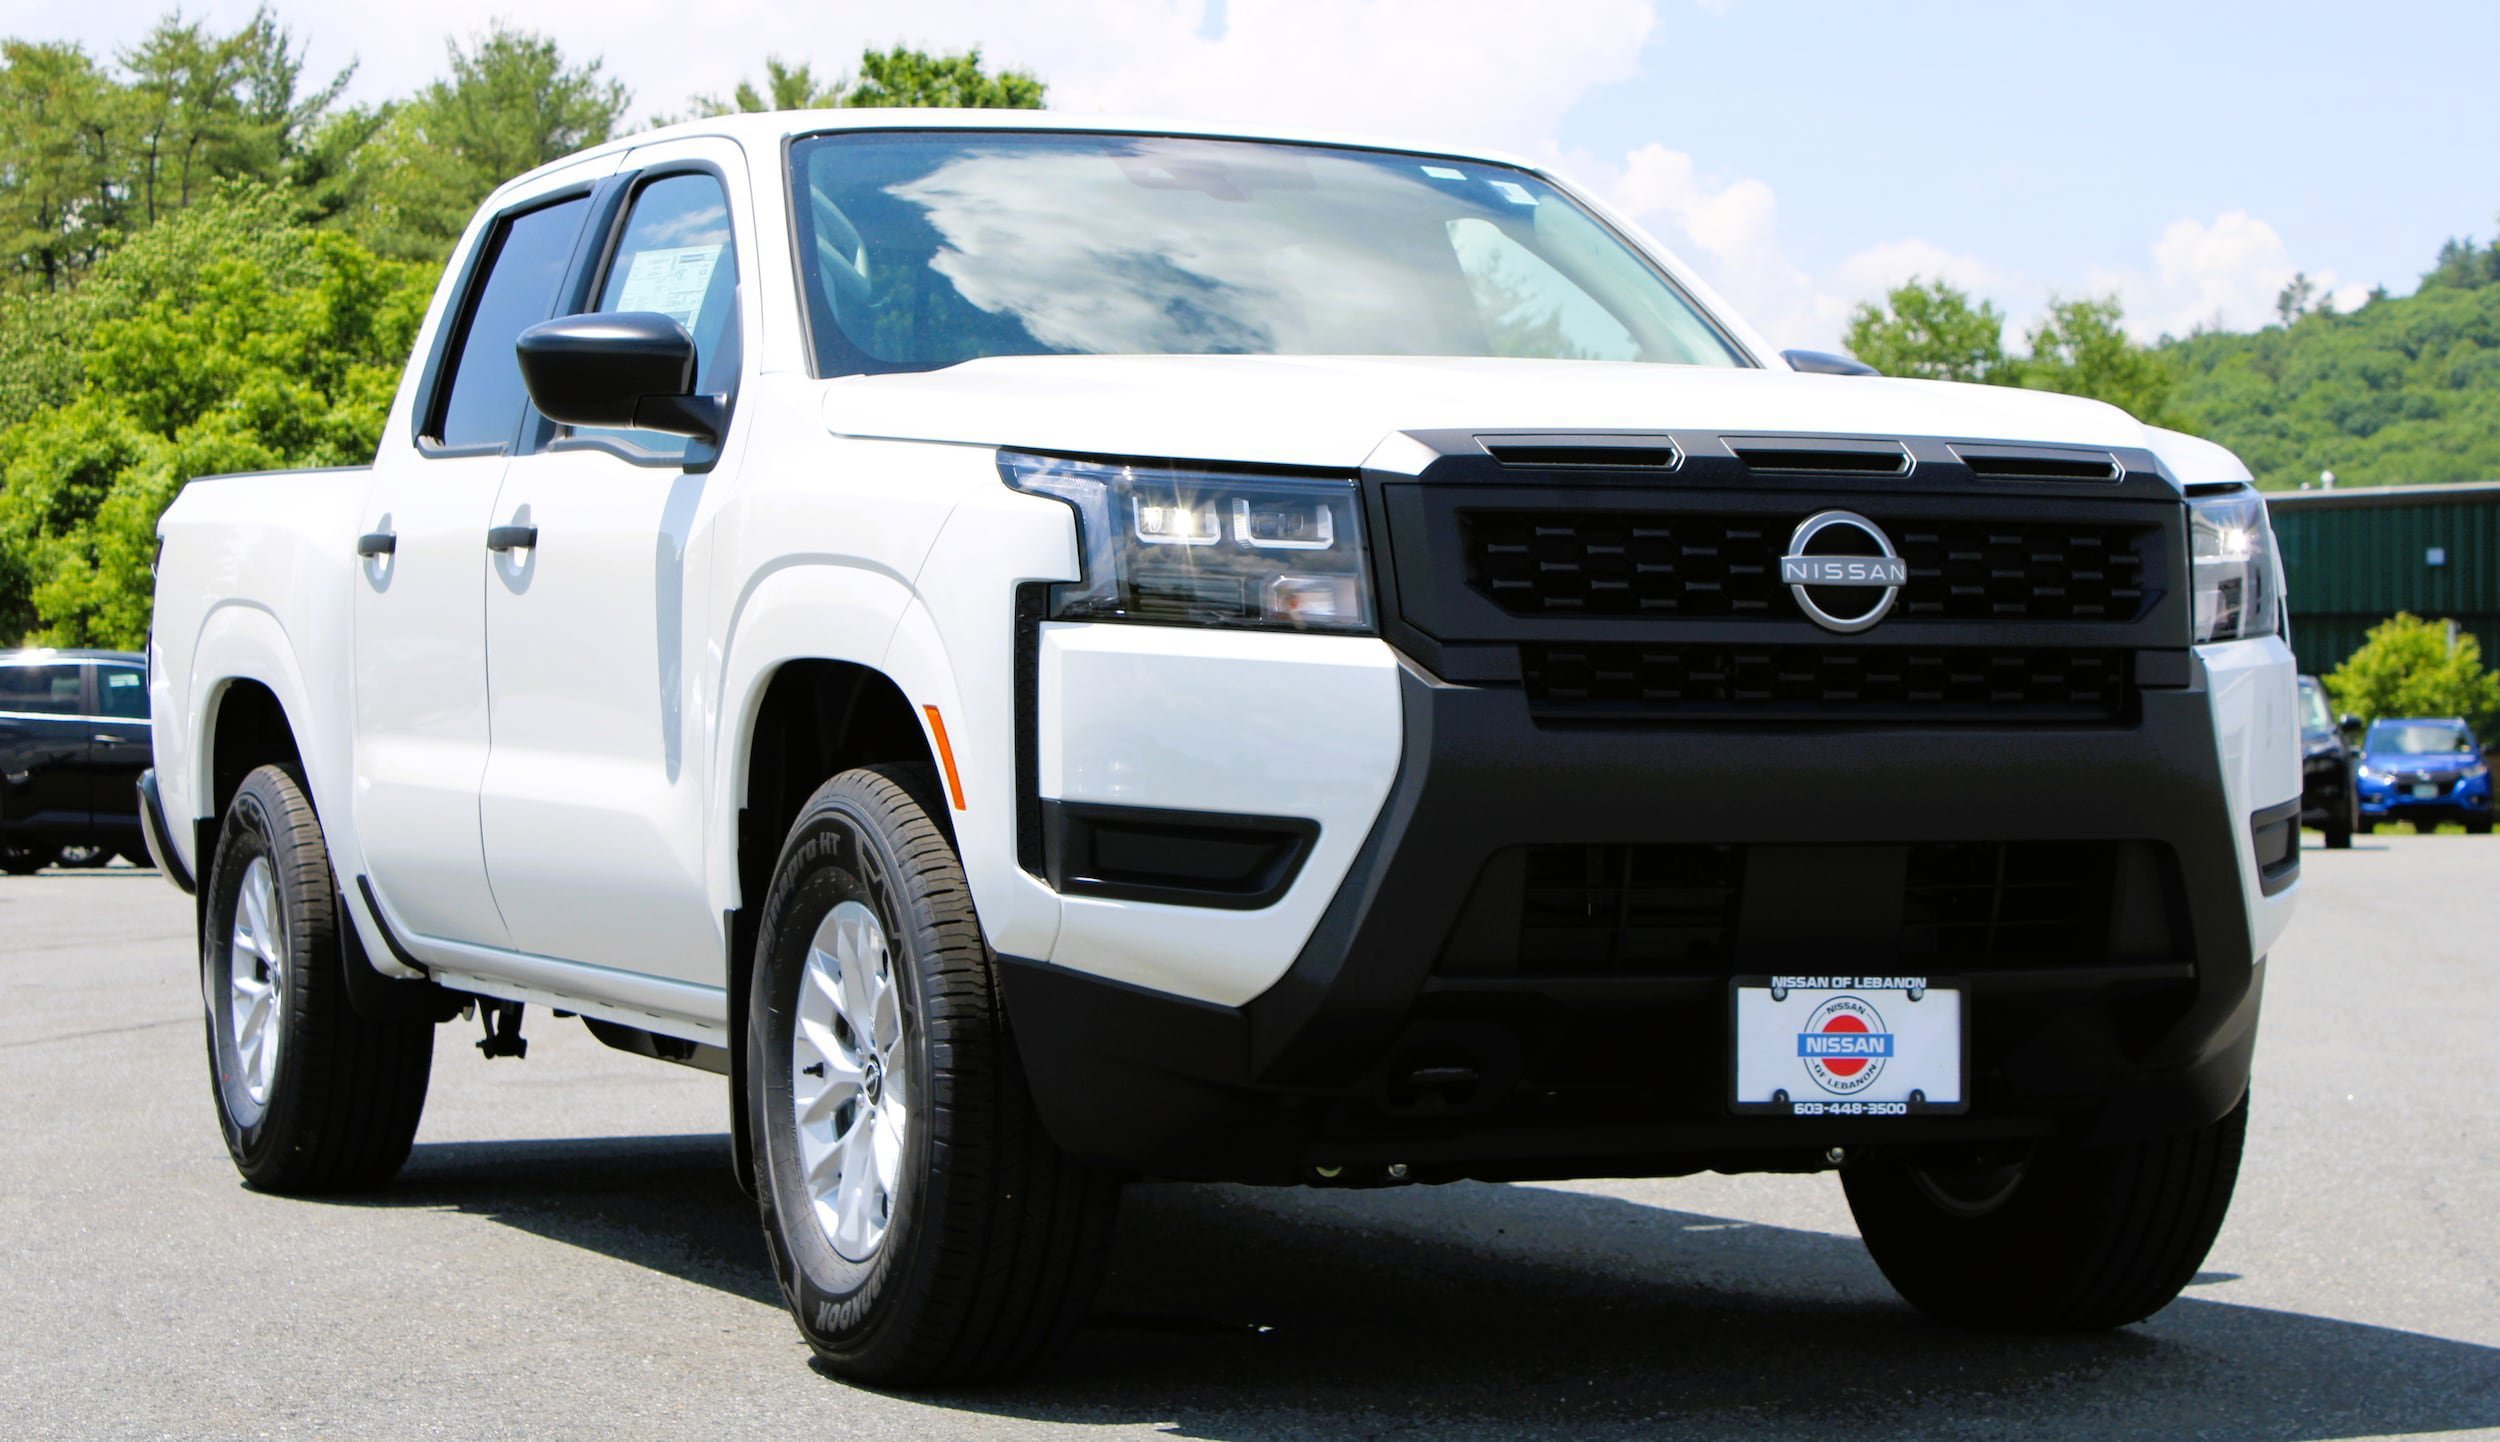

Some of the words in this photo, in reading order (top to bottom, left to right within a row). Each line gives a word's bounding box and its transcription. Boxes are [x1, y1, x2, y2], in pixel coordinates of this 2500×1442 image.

[1786, 562, 1905, 581] NISSAN
[820, 831, 841, 855] HT
[1771, 976, 1829, 989] NISSAN
[1831, 976, 1852, 989] OF
[1854, 976, 1927, 989] LEBANON
[1826, 1001, 1866, 1015] NISSAN
[1806, 1036, 1885, 1053] NISSAN
[1814, 1063, 1826, 1079] OF
[1827, 1063, 1877, 1090] LEBANON
[1793, 1103, 1907, 1115] 603-448-3500
